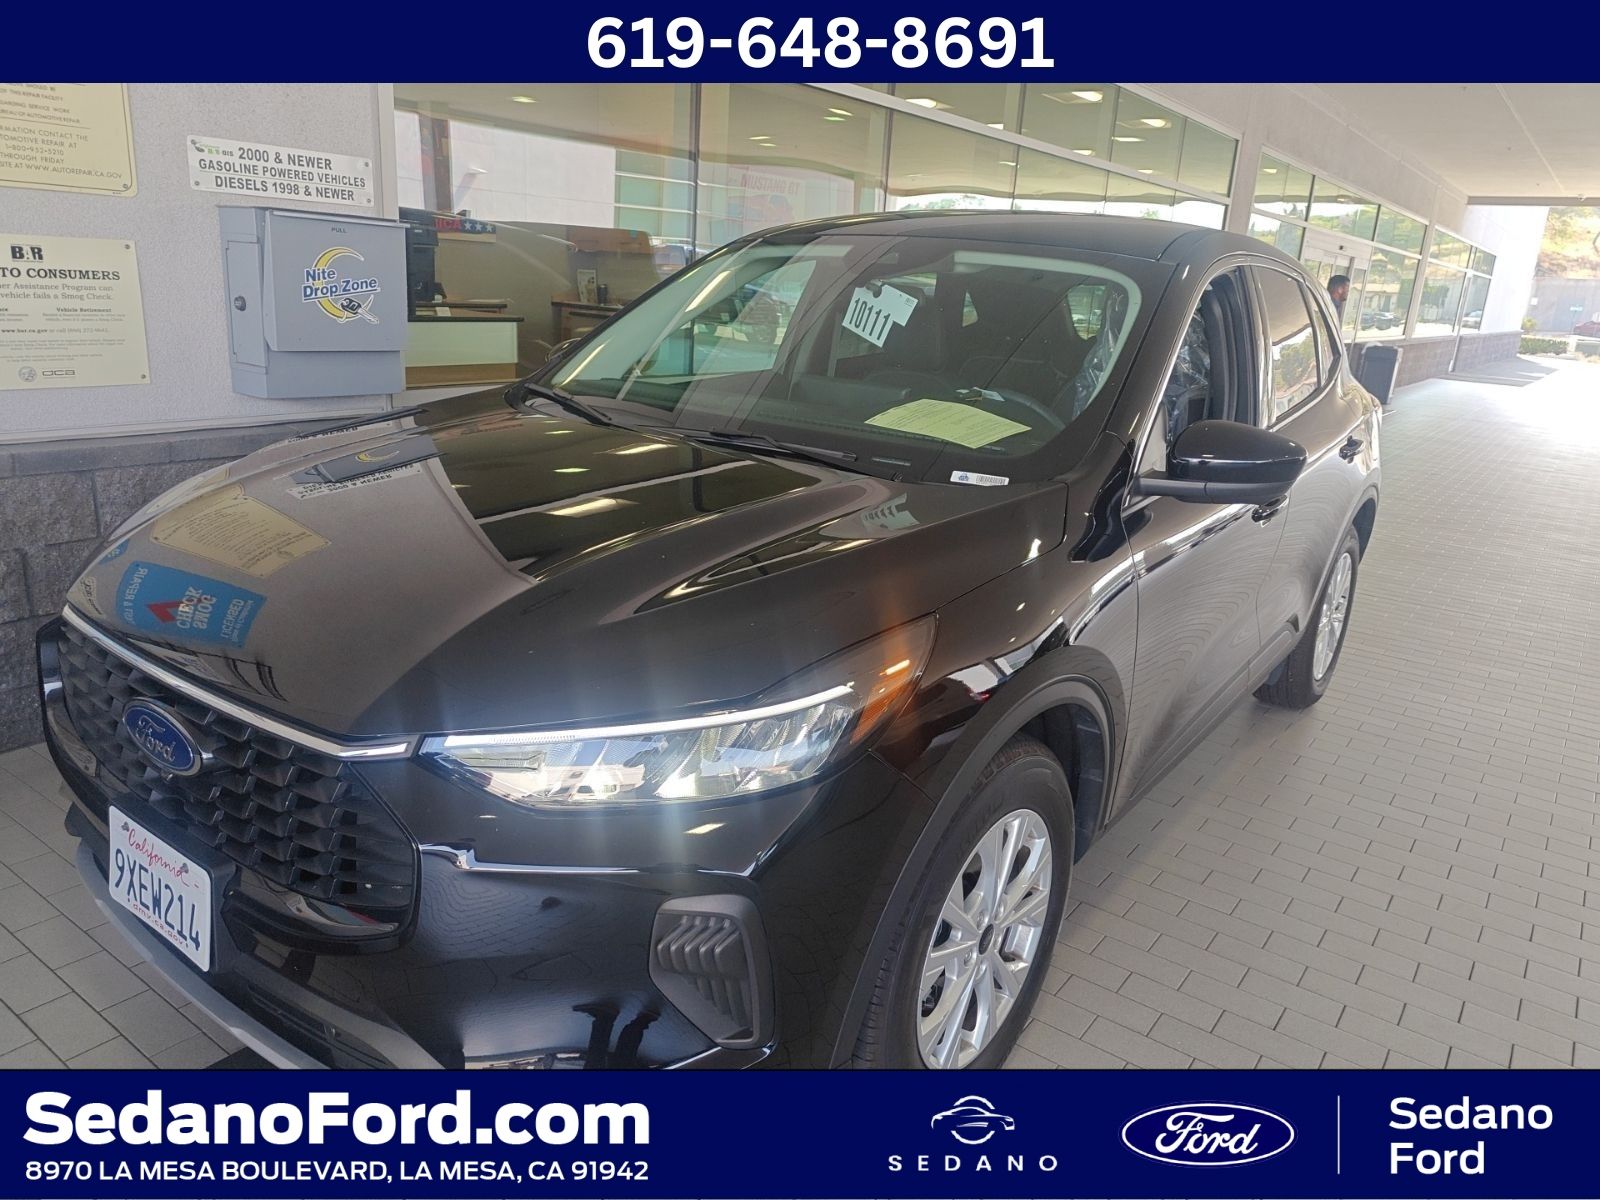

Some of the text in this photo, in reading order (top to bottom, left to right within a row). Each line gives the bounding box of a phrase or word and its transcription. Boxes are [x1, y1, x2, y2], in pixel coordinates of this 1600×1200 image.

[38, 129, 73, 140] CONTACT
[76, 134, 88, 142] THE
[41, 138, 65, 147] REPAIR
[0, 151, 64, 165] THROUGH FRIDAY
[238, 147, 270, 163] 2000
[274, 152, 283, 164] &
[287, 153, 332, 170] NEWER
[199, 158, 366, 188] GASOLINE POWERED VEHICLES
[214, 175, 355, 201] DIESELS 1998 & NEWER
[26, 267, 121, 280] CONSUMERS
[305, 268, 336, 283] Nite
[0, 291, 31, 299] vehicle
[61, 292, 84, 301] Smog
[13, 282, 59, 290] Assistance
[62, 283, 97, 293] Program
[302, 277, 378, 299] Drop Zone
[849, 297, 891, 341] 10111
[136, 714, 177, 763] Ford
[127, 828, 190, 888] California
[114, 848, 201, 952] 9XEW214
[132, 902, 185, 948] dmv.ca.gov
